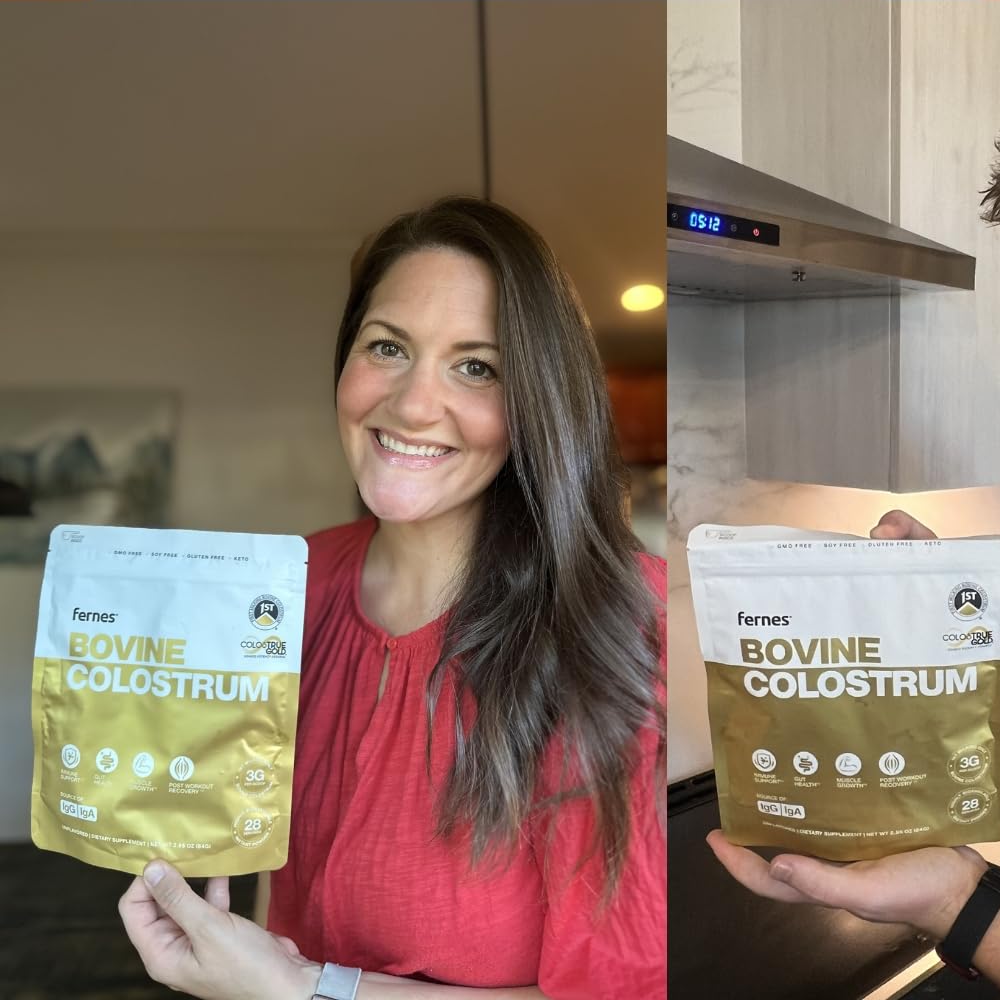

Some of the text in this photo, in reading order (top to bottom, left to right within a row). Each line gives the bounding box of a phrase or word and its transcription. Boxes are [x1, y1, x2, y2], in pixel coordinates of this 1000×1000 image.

[961, 592, 976, 604] 1ST
[72, 607, 116, 623] fernes
[260, 602, 275, 614] 1ST
[738, 611, 790, 626] fernes
[69, 631, 187, 666] BOVINE
[739, 636, 882, 664] BOVINE
[66, 663, 270, 702] COLOSTRUM
[744, 666, 978, 699] COLOSTRUM
[960, 755, 980, 768] 3G
[246, 769, 264, 782] 3G
[62, 802, 95, 819] IgG IgA
[760, 803, 802, 817] IgG IgA
[962, 798, 979, 811] 28
[244, 818, 262, 831] 28
